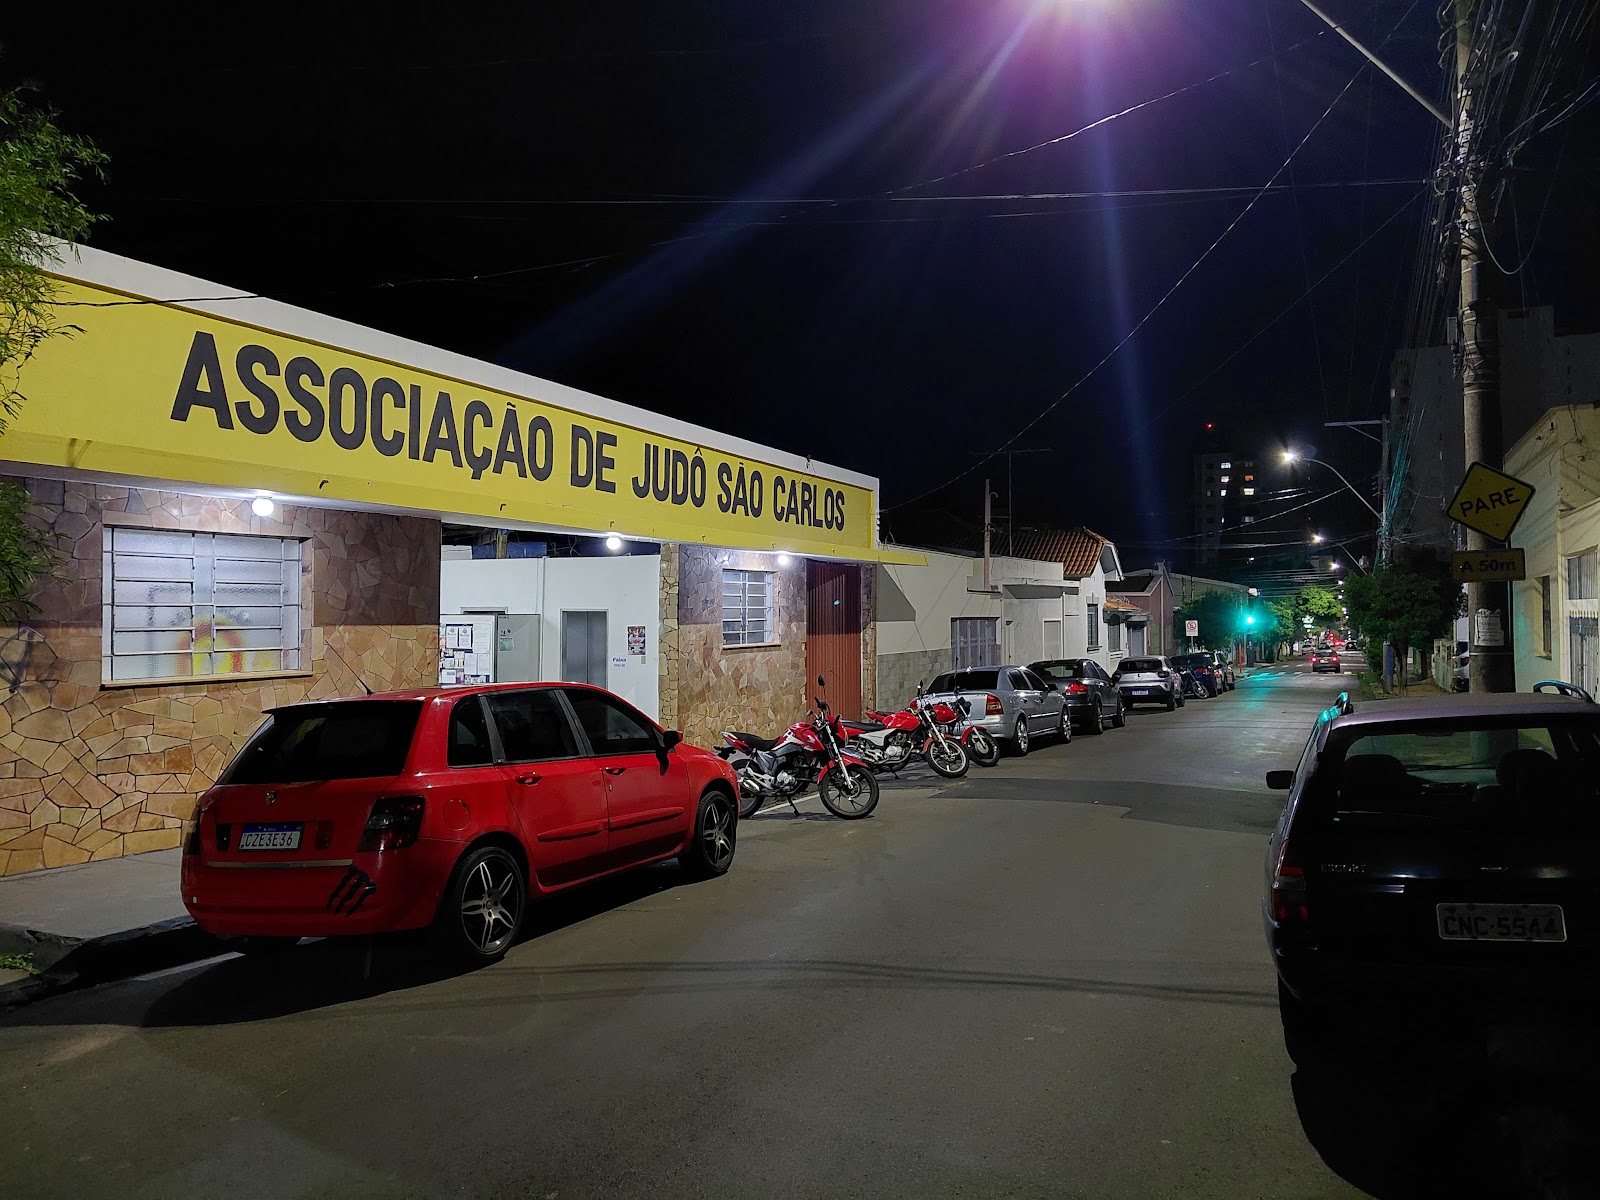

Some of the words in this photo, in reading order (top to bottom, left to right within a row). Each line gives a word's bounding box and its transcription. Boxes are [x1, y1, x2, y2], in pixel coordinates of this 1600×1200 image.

[170, 330, 554, 481] ASSOCIAÇÃO
[570, 423, 618, 494] DE
[631, 445, 706, 508] JUDÔ
[717, 461, 763, 519] SÃO
[773, 475, 846, 532] CARLOS
[1459, 487, 1521, 518] PARE
[1461, 560, 1474, 573] A
[1479, 558, 1516, 573] 50m
[245, 832, 293, 847] CZE3E36
